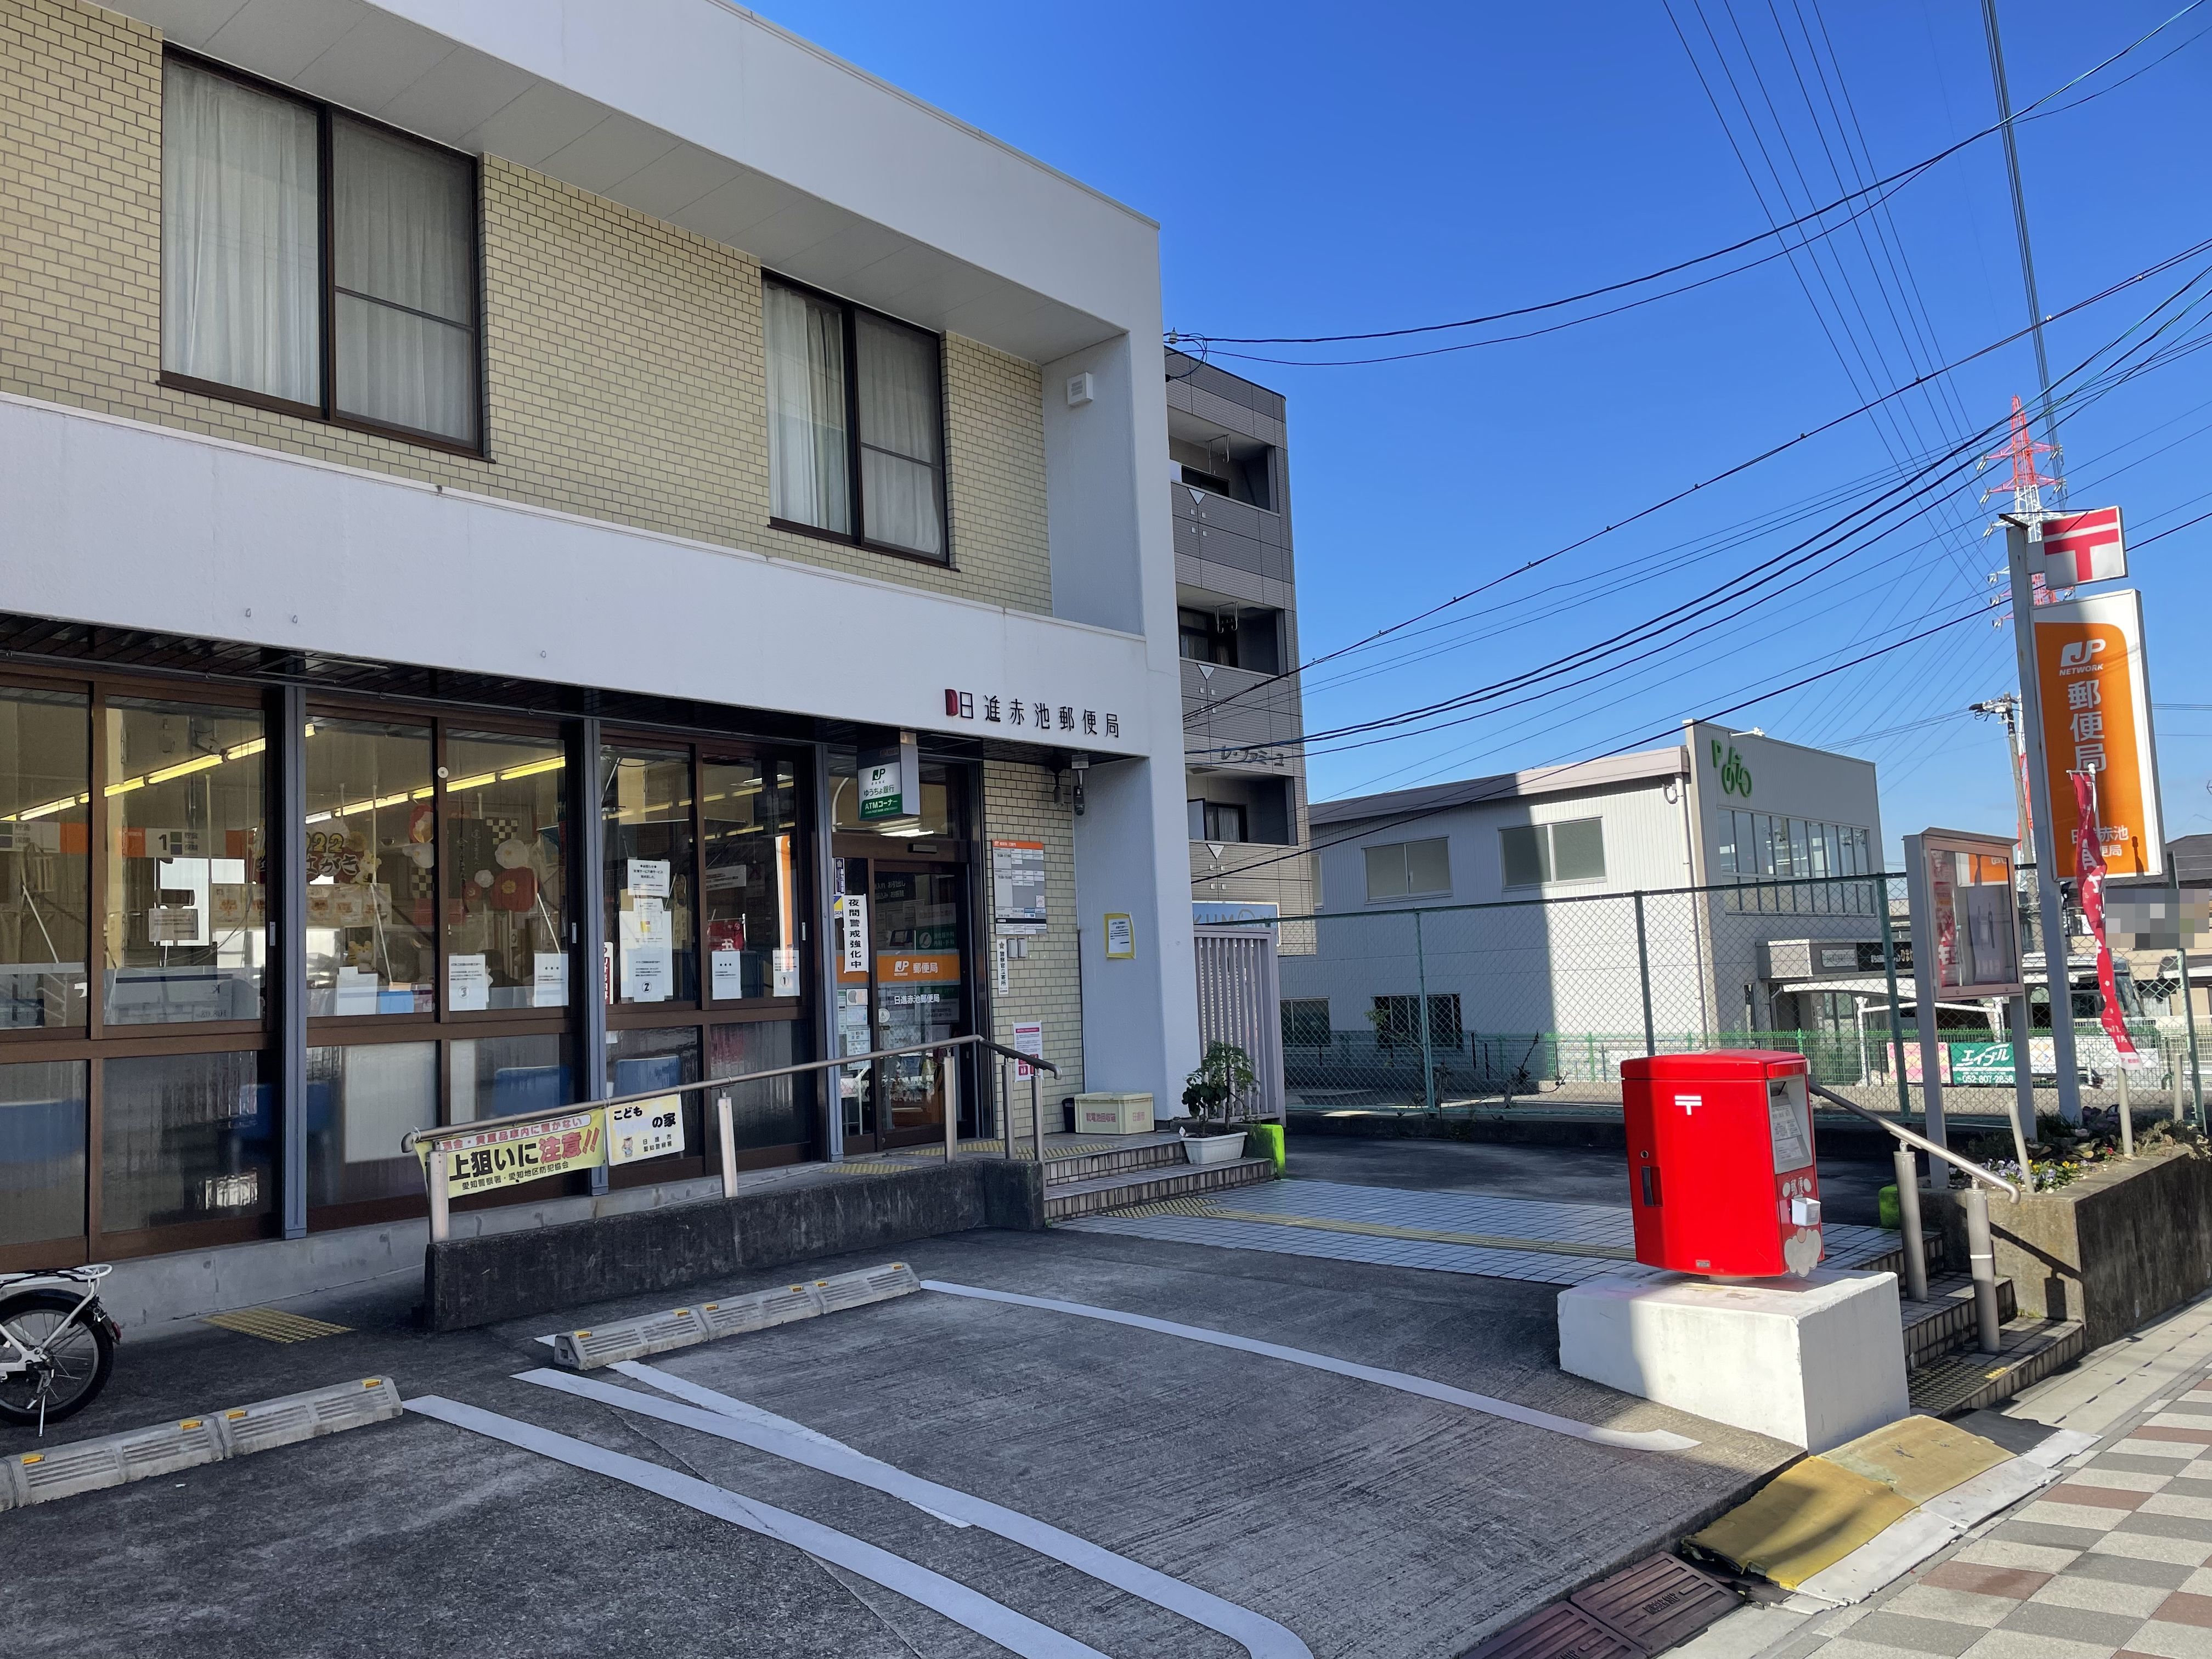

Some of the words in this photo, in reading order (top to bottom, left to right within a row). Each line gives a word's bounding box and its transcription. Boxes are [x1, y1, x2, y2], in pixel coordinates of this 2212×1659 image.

[2061, 639, 2107, 667] JP
[2059, 663, 2104, 676] NETWORK
[959, 691, 1119, 738] 日進赤池郵便局
[2068, 679, 2107, 772] 郵便局
[872, 768, 885, 781] JP
[864, 785, 895, 797] ゆうちょ銀行
[865, 798, 898, 810] ATMコーナー
[159, 834, 167, 851] 1
[848, 899, 862, 968] 夜間警戒強化中
[913, 962, 938, 974] 郵便局
[894, 994, 940, 1005] 日進赤池郵便局
[1956, 1043, 2010, 1066] エイブル
[614, 1106, 642, 1120] こども
[652, 1113, 676, 1128] の家
[461, 1161, 569, 1190] 愛知警察署・愛知地区防犯協会
